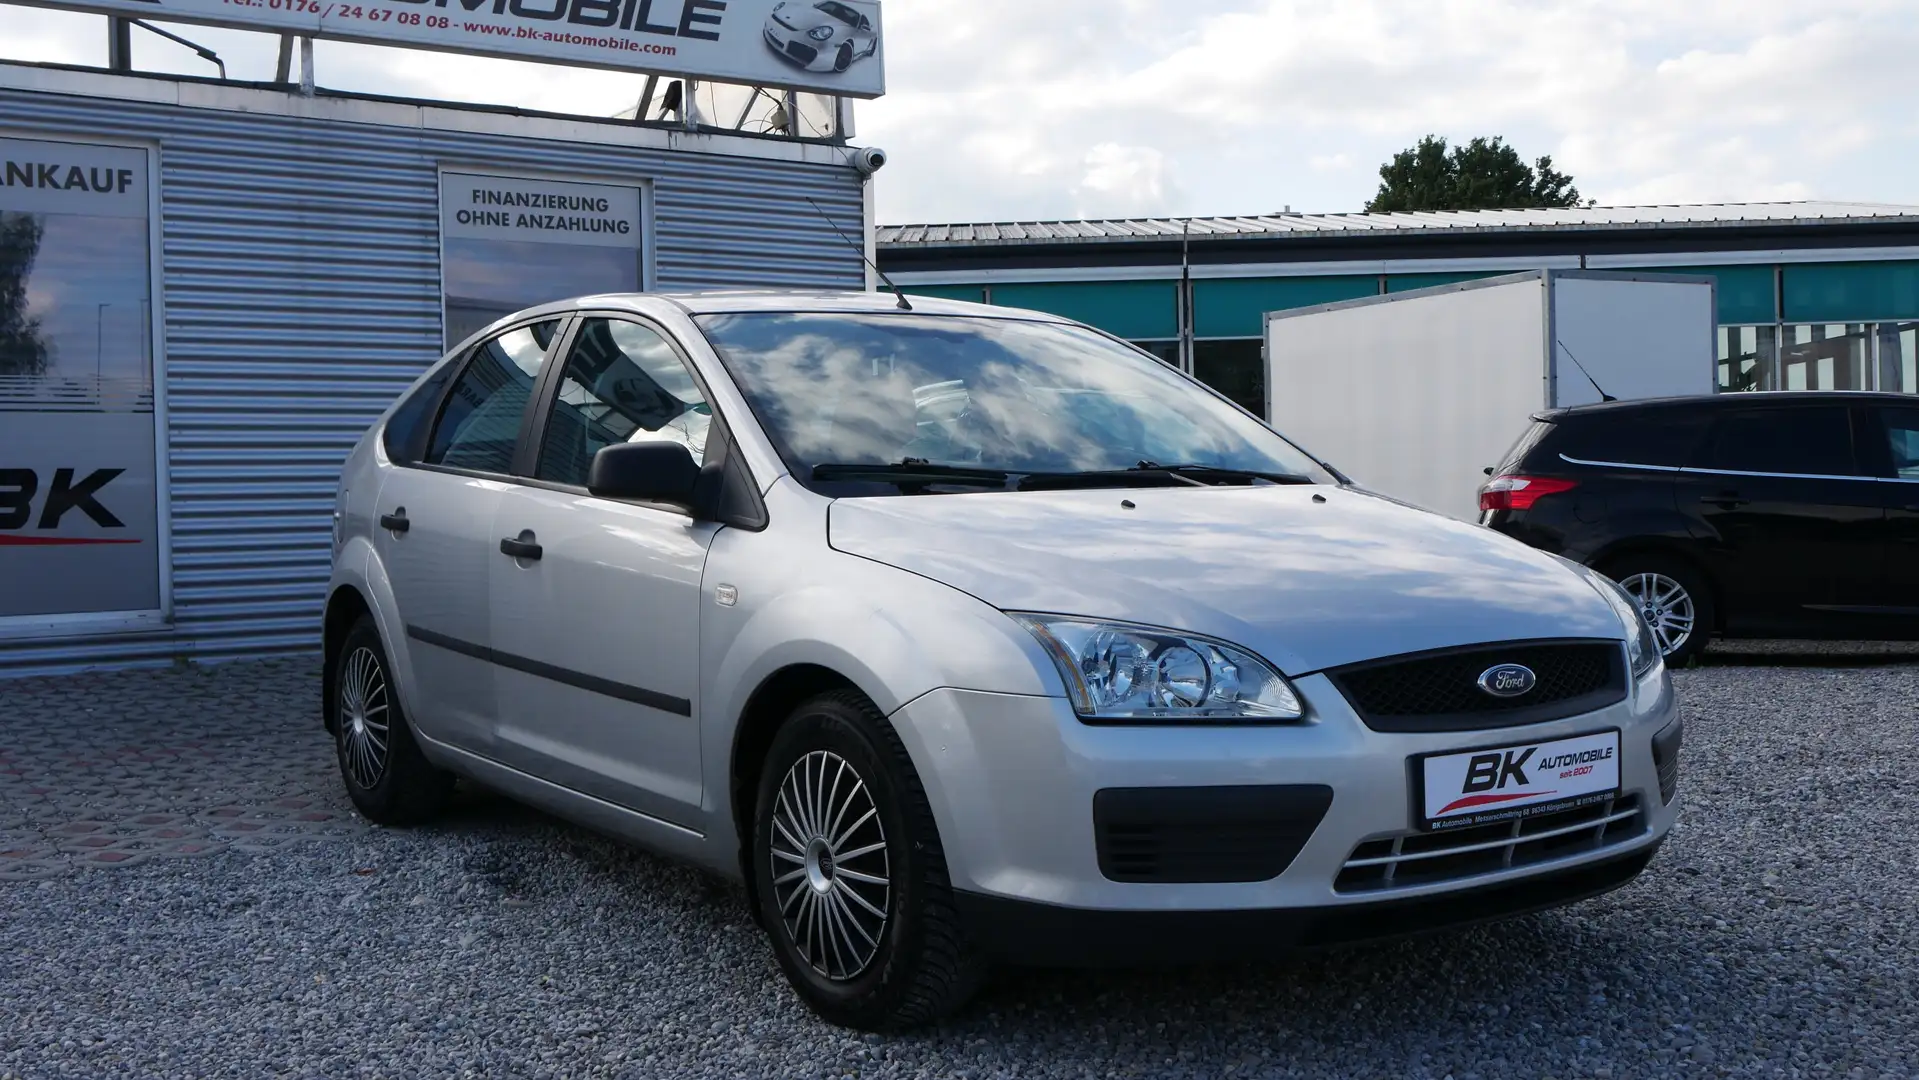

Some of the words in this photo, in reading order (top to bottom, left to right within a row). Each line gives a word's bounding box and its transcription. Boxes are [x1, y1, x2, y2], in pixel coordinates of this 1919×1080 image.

[338, 5, 363, 18] 24
[368, 8, 392, 22] 67
[397, 12, 421, 25] 08
[426, 15, 449, 28] 08
[464, 22, 677, 56] www.bk-automobile.com
[0, 161, 133, 193] NKAUF
[472, 189, 609, 212] FINANZIERUNG
[456, 210, 510, 226] OHNE
[516, 214, 630, 234] ANZAHLUNG
[1496, 670, 1525, 690] Ford
[1462, 747, 1538, 794] BK
[1538, 747, 1613, 771] AUTOMOBILE
[1559, 769, 1573, 779] seit
[1573, 765, 1593, 777] 2007
[1432, 821, 1441, 829] BK
[1442, 816, 1473, 827] Automobile
